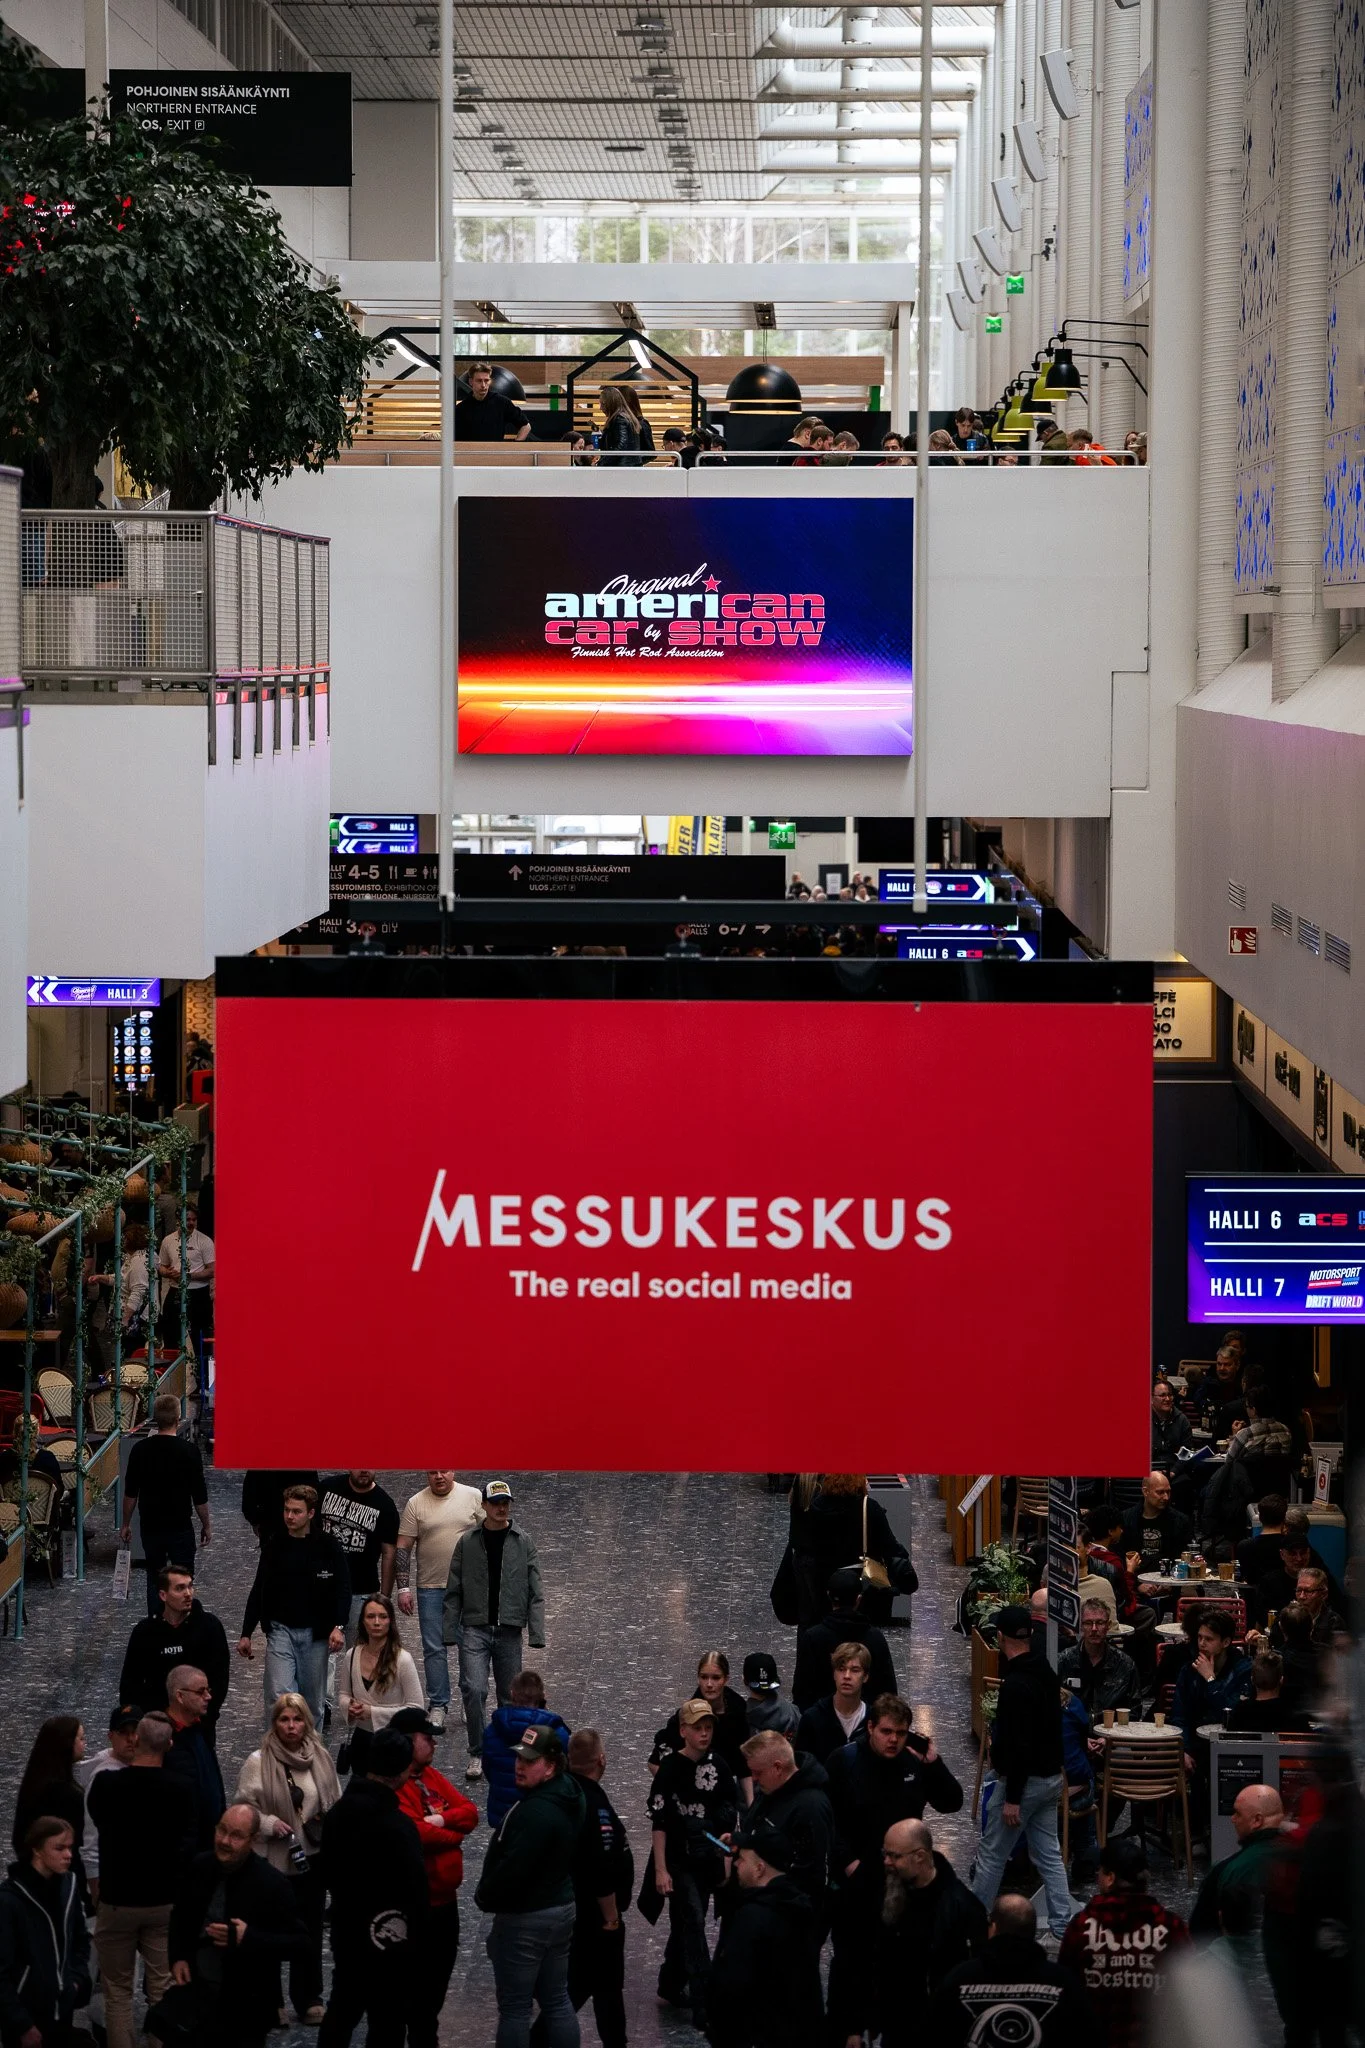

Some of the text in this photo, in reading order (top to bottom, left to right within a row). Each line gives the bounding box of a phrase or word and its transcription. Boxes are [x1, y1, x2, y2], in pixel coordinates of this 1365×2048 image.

[126, 84, 290, 98] POHJOINEN SISÄÄNKÄYNTI
[126, 102, 257, 115] NORTHERN ENTRANCE
[138, 119, 162, 131] OS,
[167, 119, 191, 130] EXIT
[597, 562, 708, 605] Original
[544, 620, 639, 645] car
[643, 623, 662, 641] by
[571, 646, 725, 659] Finnish Hot Rod Association
[389, 823, 415, 831] HALLI 3
[330, 864, 346, 872] LLIT
[348, 864, 380, 880] 4-5
[575, 865, 631, 873] SISÄÄNKÄYNTI
[330, 872, 343, 880] LLS
[529, 874, 609, 882] NORTHERN ENTRANCE
[384, 884, 426, 892] EXHIBITION
[887, 882, 910, 892] HALLI
[319, 918, 342, 926] HALLI
[319, 926, 339, 934] HALL
[909, 948, 949, 959] HALLI 6
[107, 988, 136, 999] HALLI
[141, 988, 149, 999] 3
[1153, 989, 1177, 1003] FFÈ
[1154, 1007, 1175, 1019] LCI
[1153, 1022, 1172, 1034] NO
[1153, 1038, 1183, 1050] ATO
[411, 1168, 953, 1272] MESSUKESKUS
[1209, 1210, 1282, 1230] HALLI 6
[1298, 1212, 1349, 1227] acs
[1308, 1266, 1363, 1282] MOTORSPORT
[509, 1270, 853, 1301] The real social media
[1210, 1277, 1285, 1297] HALLI 7
[1305, 1294, 1364, 1309] DRIFT WORLD
[320, 1491, 381, 1532] GARAGE SERVICES
[1109, 1952, 1136, 1968] and
